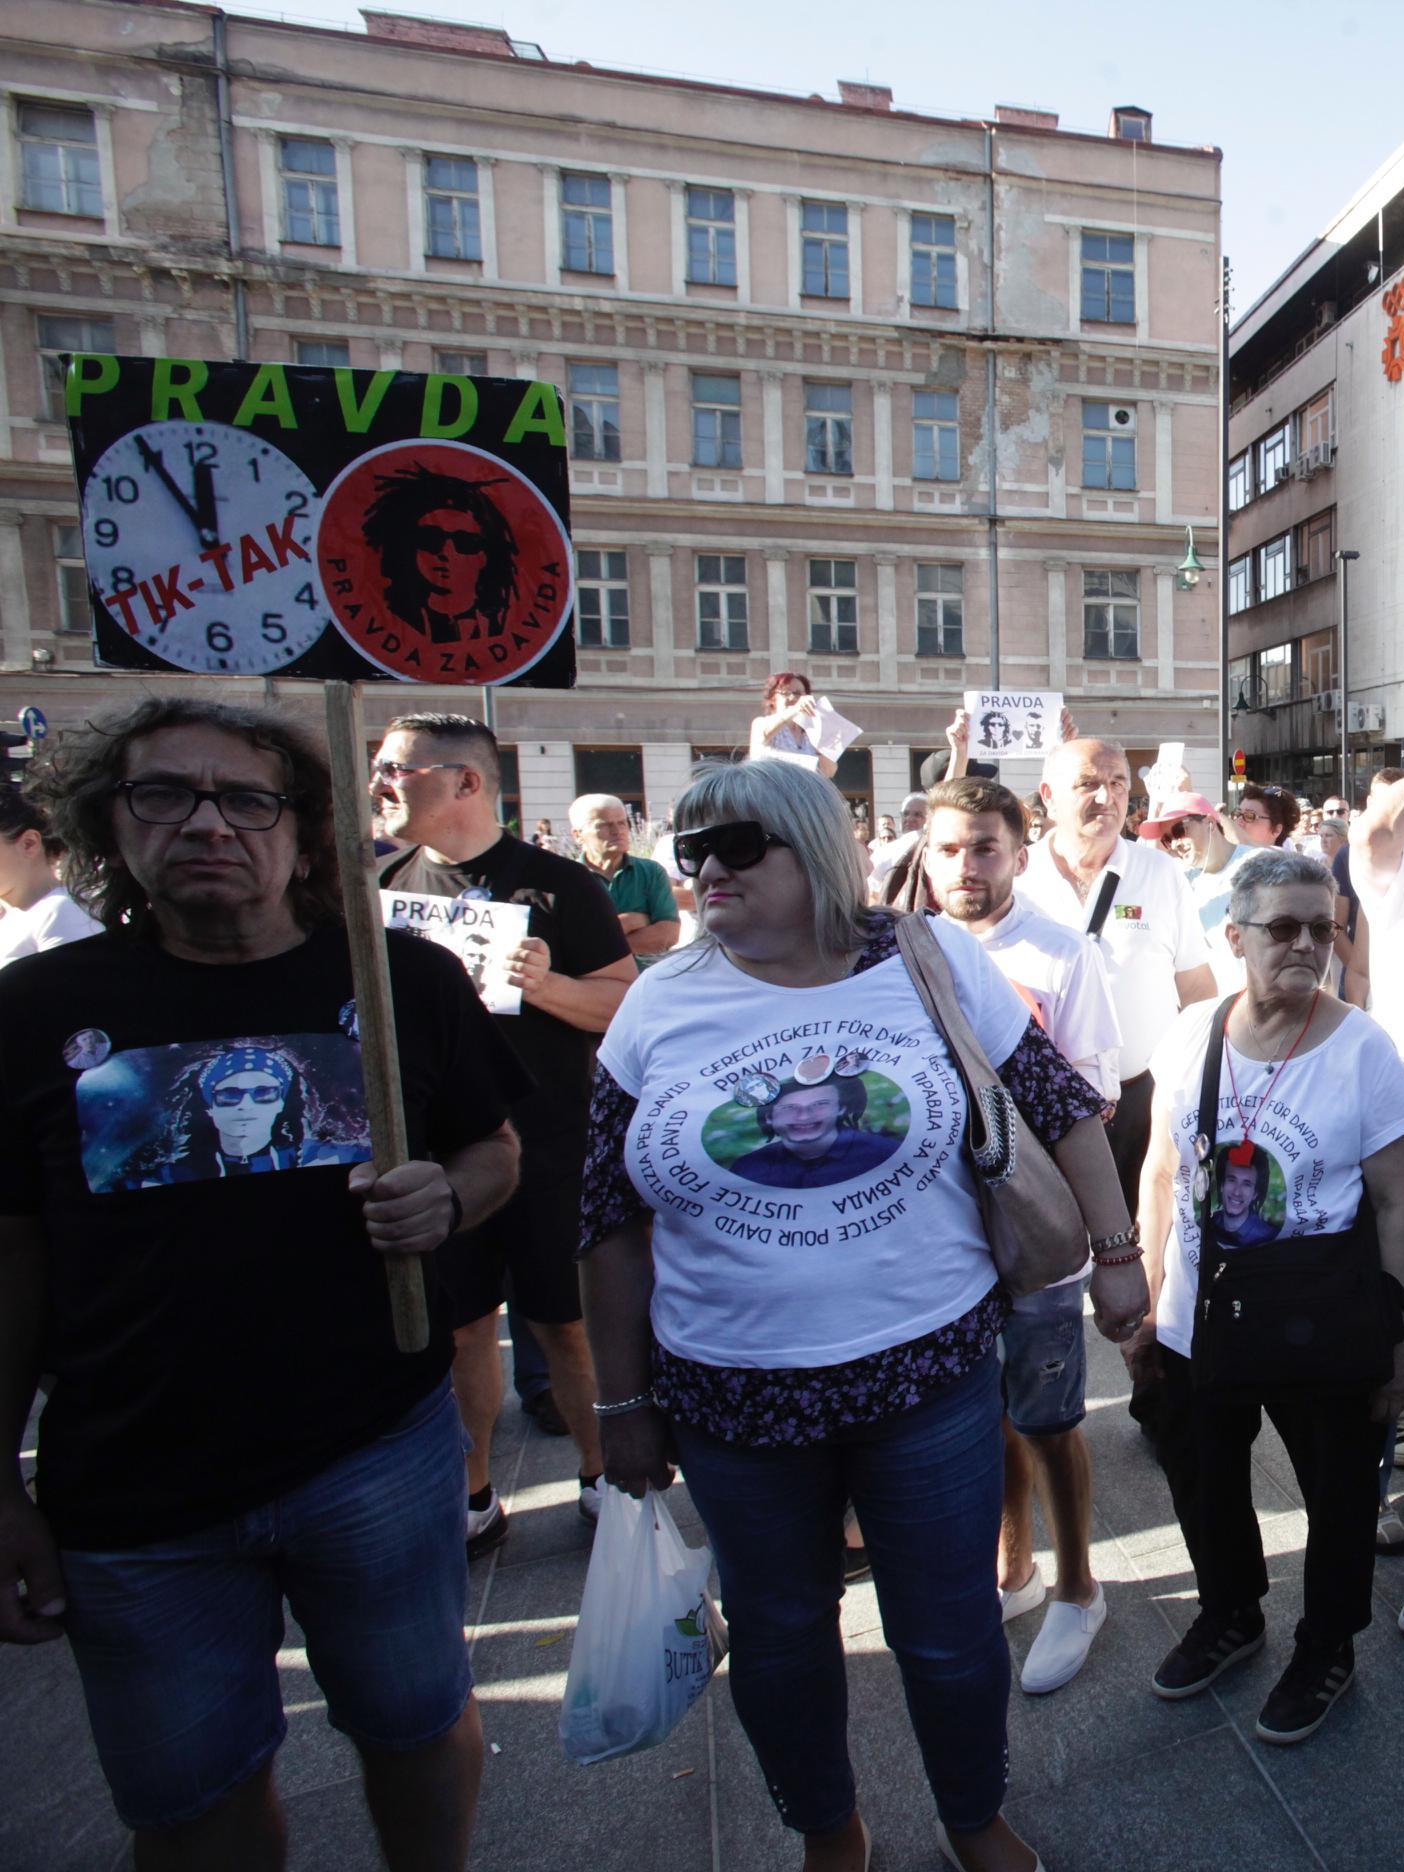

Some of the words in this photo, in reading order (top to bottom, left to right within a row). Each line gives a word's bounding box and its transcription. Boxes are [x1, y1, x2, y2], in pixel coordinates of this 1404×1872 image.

[66, 353, 567, 447] PRAVDA
[183, 442, 220, 468] 12
[247, 458, 260, 484] 1
[102, 476, 140, 504] 10
[285, 491, 309, 517] 2
[94, 518, 119, 548] 9
[105, 515, 310, 636] TIK-TAK
[294, 582, 319, 610] 4
[261, 613, 287, 643] 5
[327, 558, 421, 666] PRAVDA
[439, 652, 481, 672] ZA
[488, 561, 561, 662] DAVIDA
[206, 621, 234, 653] 6
[981, 695, 1044, 709] PRAVDA
[392, 899, 495, 928] PRAVDA
[700, 1021, 832, 1077] GERECHTIGKEIT
[837, 1020, 873, 1038] FÜR
[875, 1027, 920, 1048] DAVID
[920, 1053, 960, 1106] JUSTICIA
[648, 1081, 691, 1117] DAVID
[912, 1071, 943, 1131] ПРАВДА
[637, 1122, 655, 1150] PER
[661, 1110, 688, 1160] DAVID
[945, 1111, 962, 1146] PARA
[1267, 1100, 1290, 1120] FÜR
[1289, 1114, 1319, 1149] DAVID
[913, 1138, 936, 1159] ЗА
[1260, 1121, 1301, 1163] DAVIDA
[638, 1153, 704, 1218] GIUSTIZIA
[668, 1160, 710, 1193] FOR
[916, 1150, 950, 1192] DAVID
[710, 1187, 803, 1220] JUSTICE
[832, 1162, 915, 1215] ДАВИДА
[715, 1215, 772, 1244] DAVID
[837, 1198, 907, 1242] JUSTICE
[778, 1229, 829, 1247] POUR
